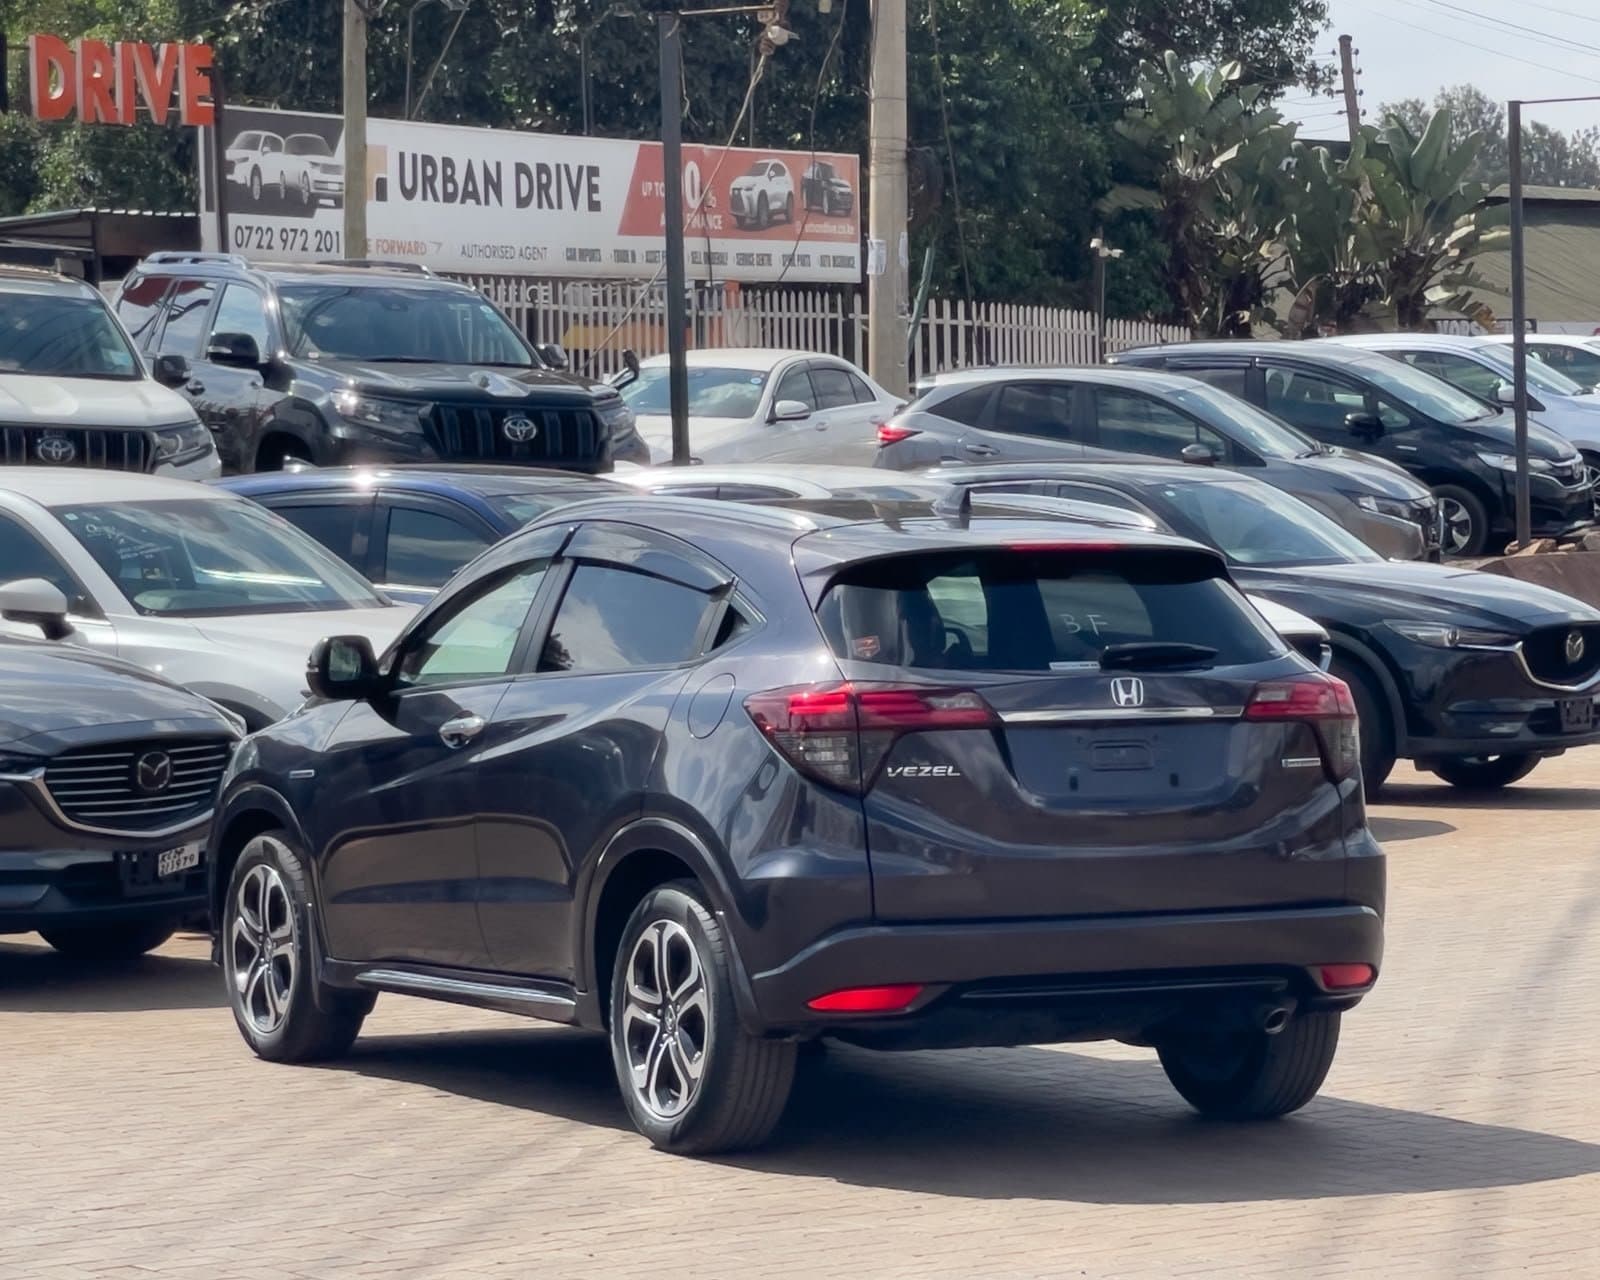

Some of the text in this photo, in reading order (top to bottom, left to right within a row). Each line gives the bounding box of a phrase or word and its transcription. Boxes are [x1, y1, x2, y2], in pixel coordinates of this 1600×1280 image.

[29, 33, 215, 126] DRIVE
[399, 151, 601, 212] URBAN DRIVE
[642, 181, 653, 197] UP
[235, 225, 339, 253] 0722 972 201
[375, 239, 427, 256] FORWARD
[460, 244, 548, 261] AUTHORISED AGENT
[887, 765, 961, 777] VEZEL
